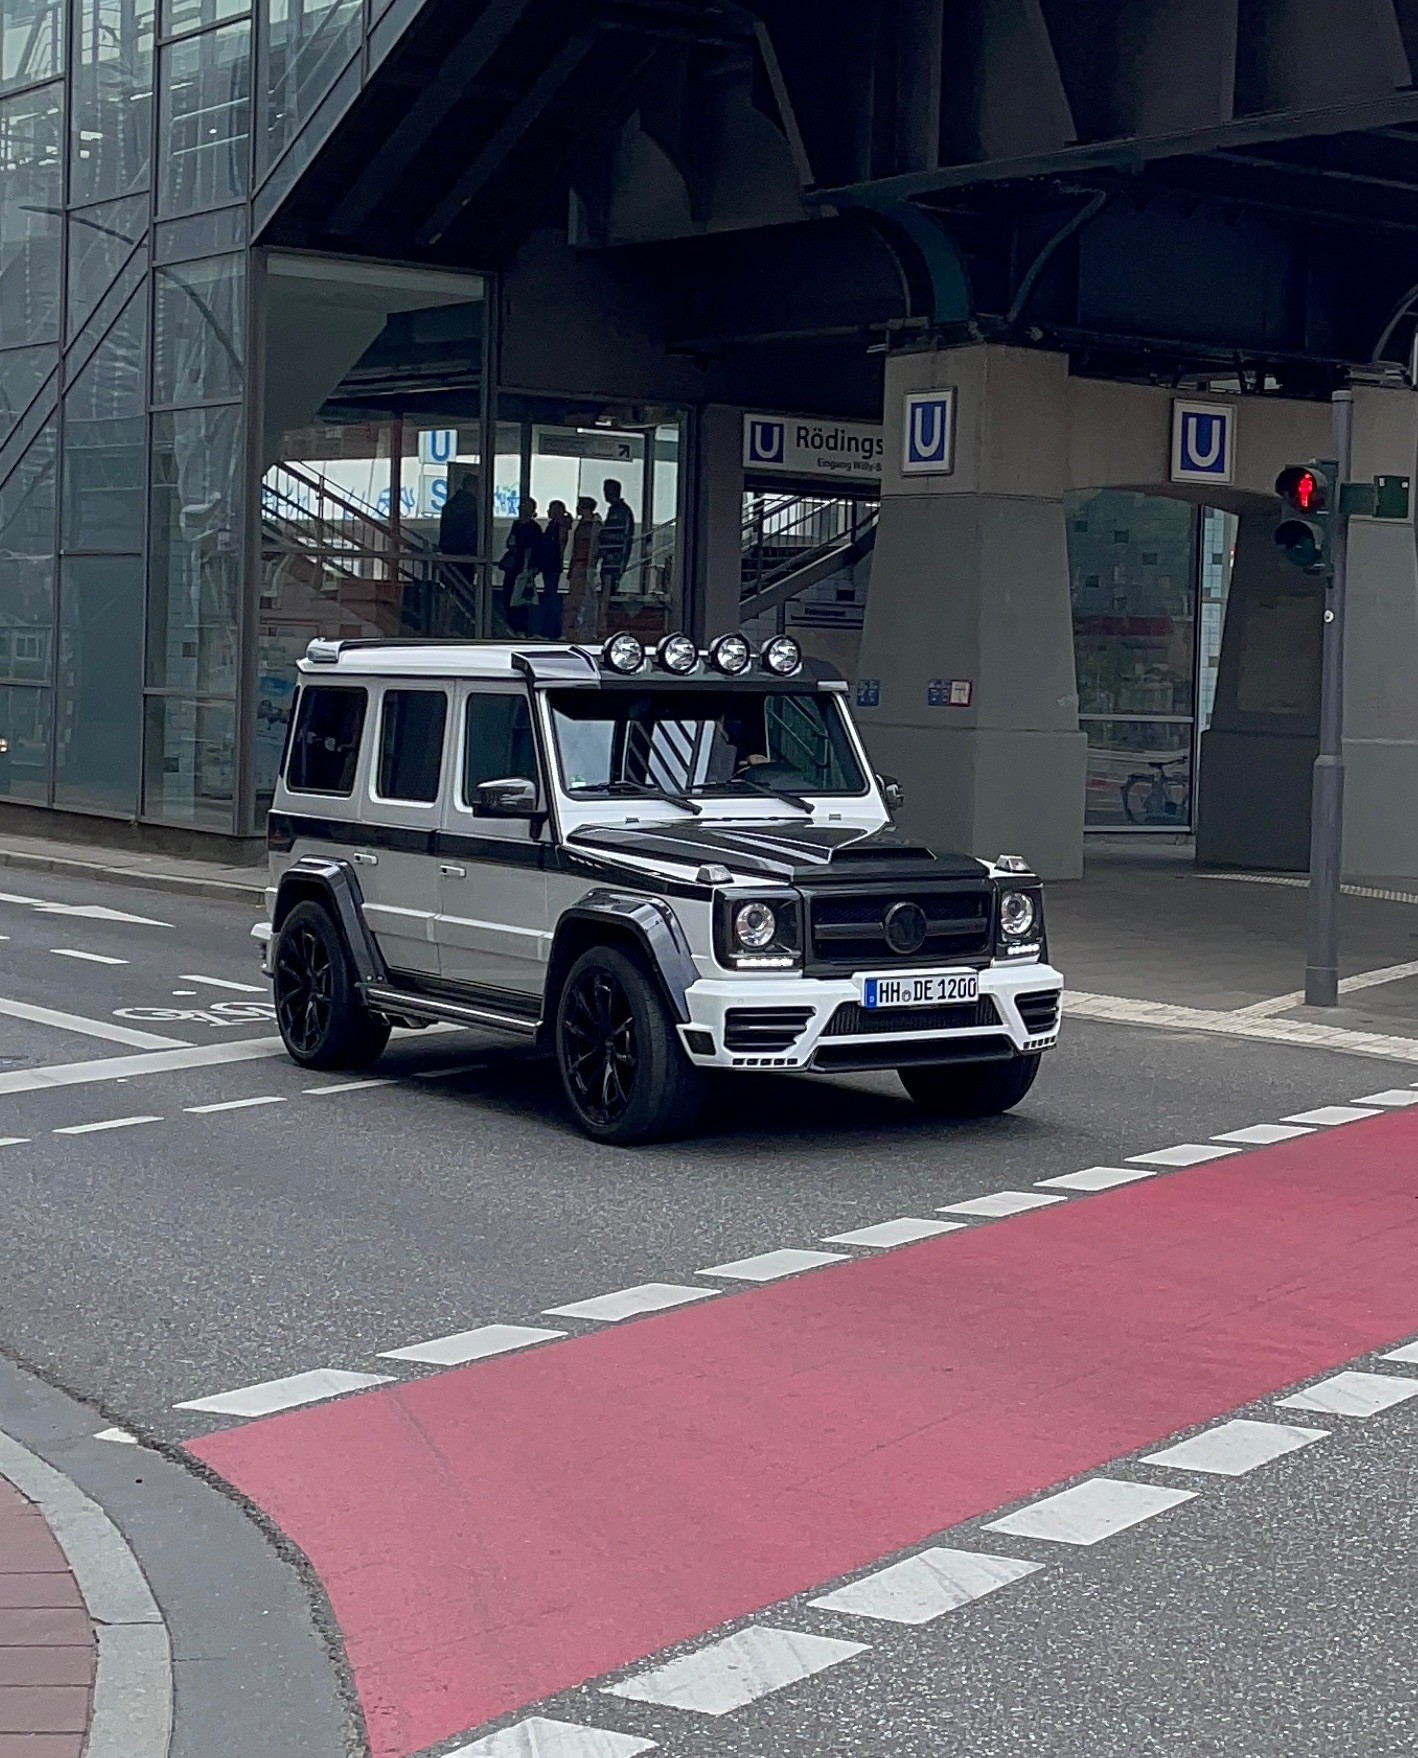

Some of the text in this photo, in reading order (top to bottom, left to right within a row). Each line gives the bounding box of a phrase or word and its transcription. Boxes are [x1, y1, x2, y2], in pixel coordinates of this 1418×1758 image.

[431, 430, 450, 462] U
[755, 425, 779, 459] U
[914, 406, 942, 458] U
[1187, 417, 1220, 467] U
[879, 978, 977, 1003] HH DE 1200
